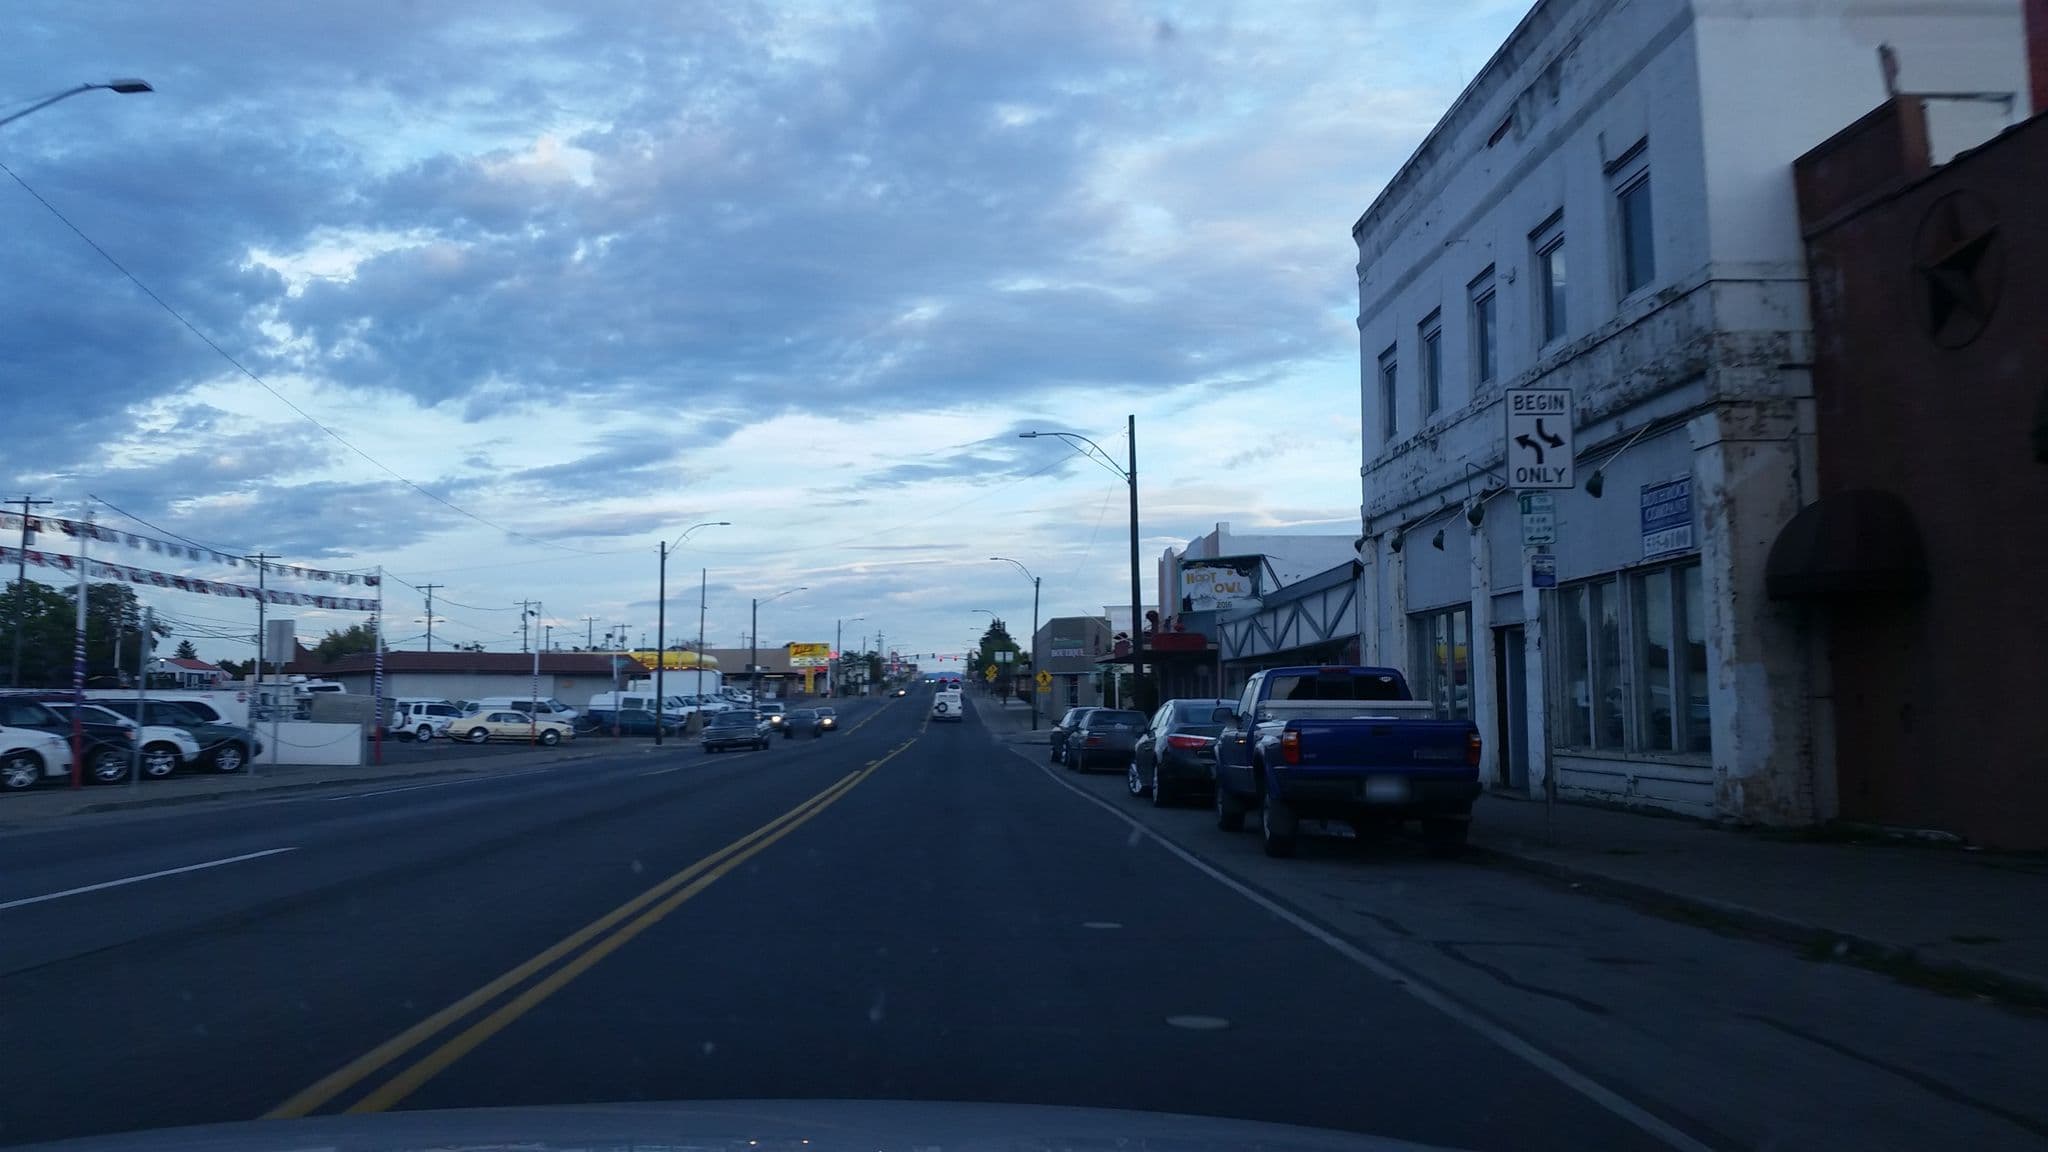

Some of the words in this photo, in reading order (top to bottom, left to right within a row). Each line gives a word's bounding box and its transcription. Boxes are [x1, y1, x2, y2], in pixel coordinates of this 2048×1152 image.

[1513, 394, 1565, 411] BEGIN
[1515, 466, 1566, 484] ONLY
[1186, 572, 1217, 585] HOOT
[1214, 581, 1241, 594] OWL
